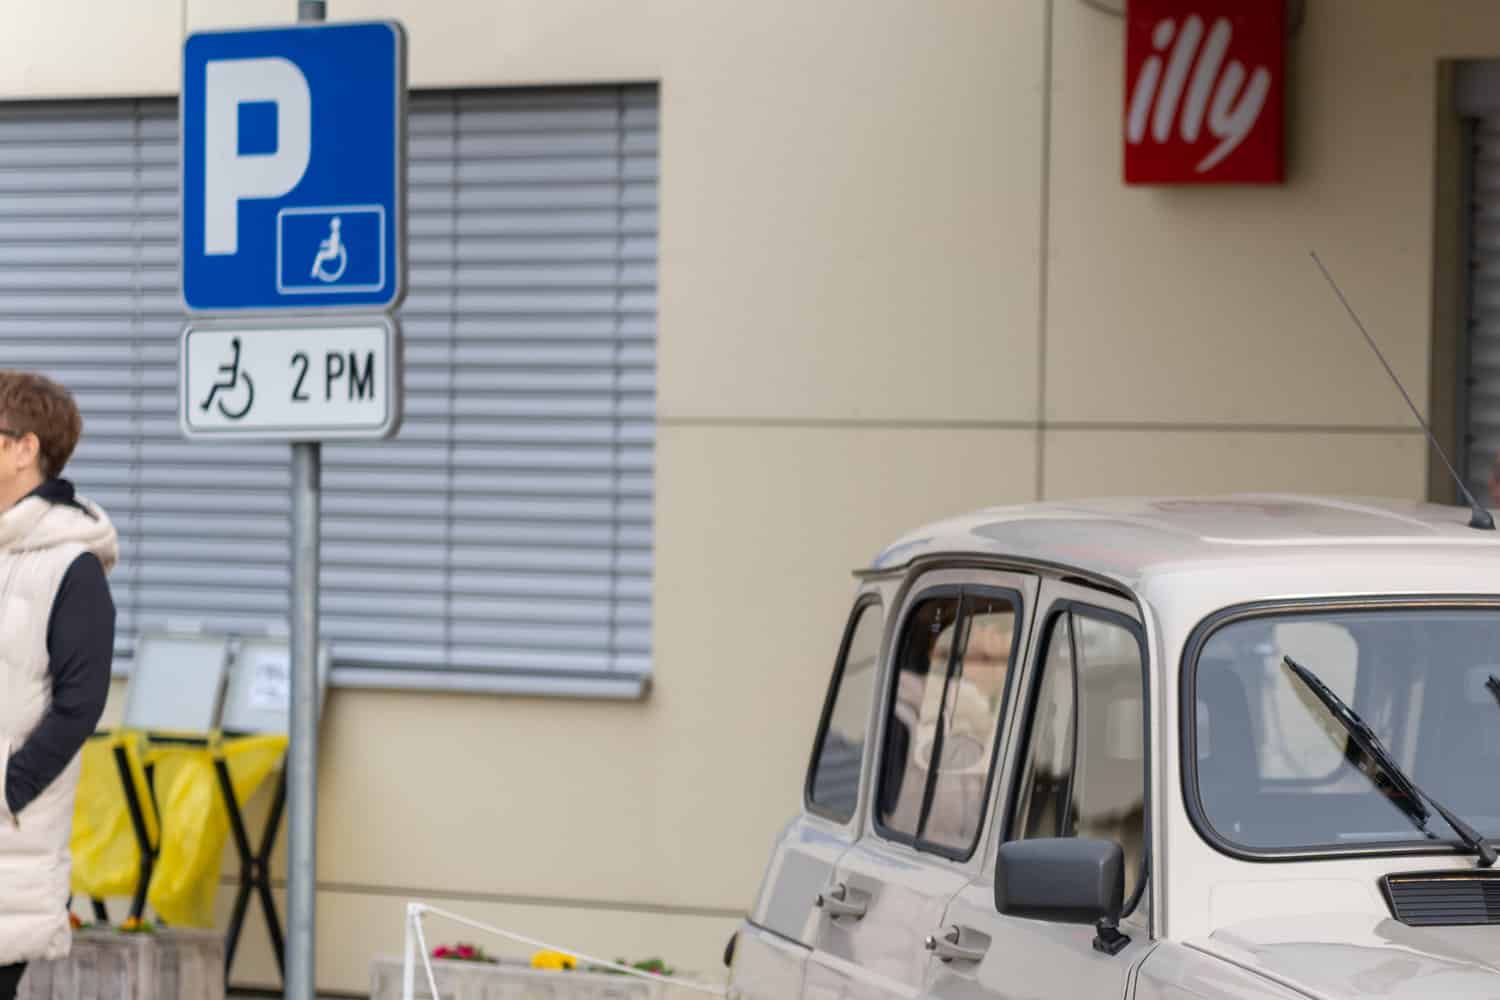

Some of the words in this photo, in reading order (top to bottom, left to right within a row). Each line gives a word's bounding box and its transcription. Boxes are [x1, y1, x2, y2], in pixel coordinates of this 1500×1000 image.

[204, 57, 311, 256] P
[1127, 13, 1271, 172] illy
[290, 351, 309, 402] 2
[325, 351, 374, 402] PM
